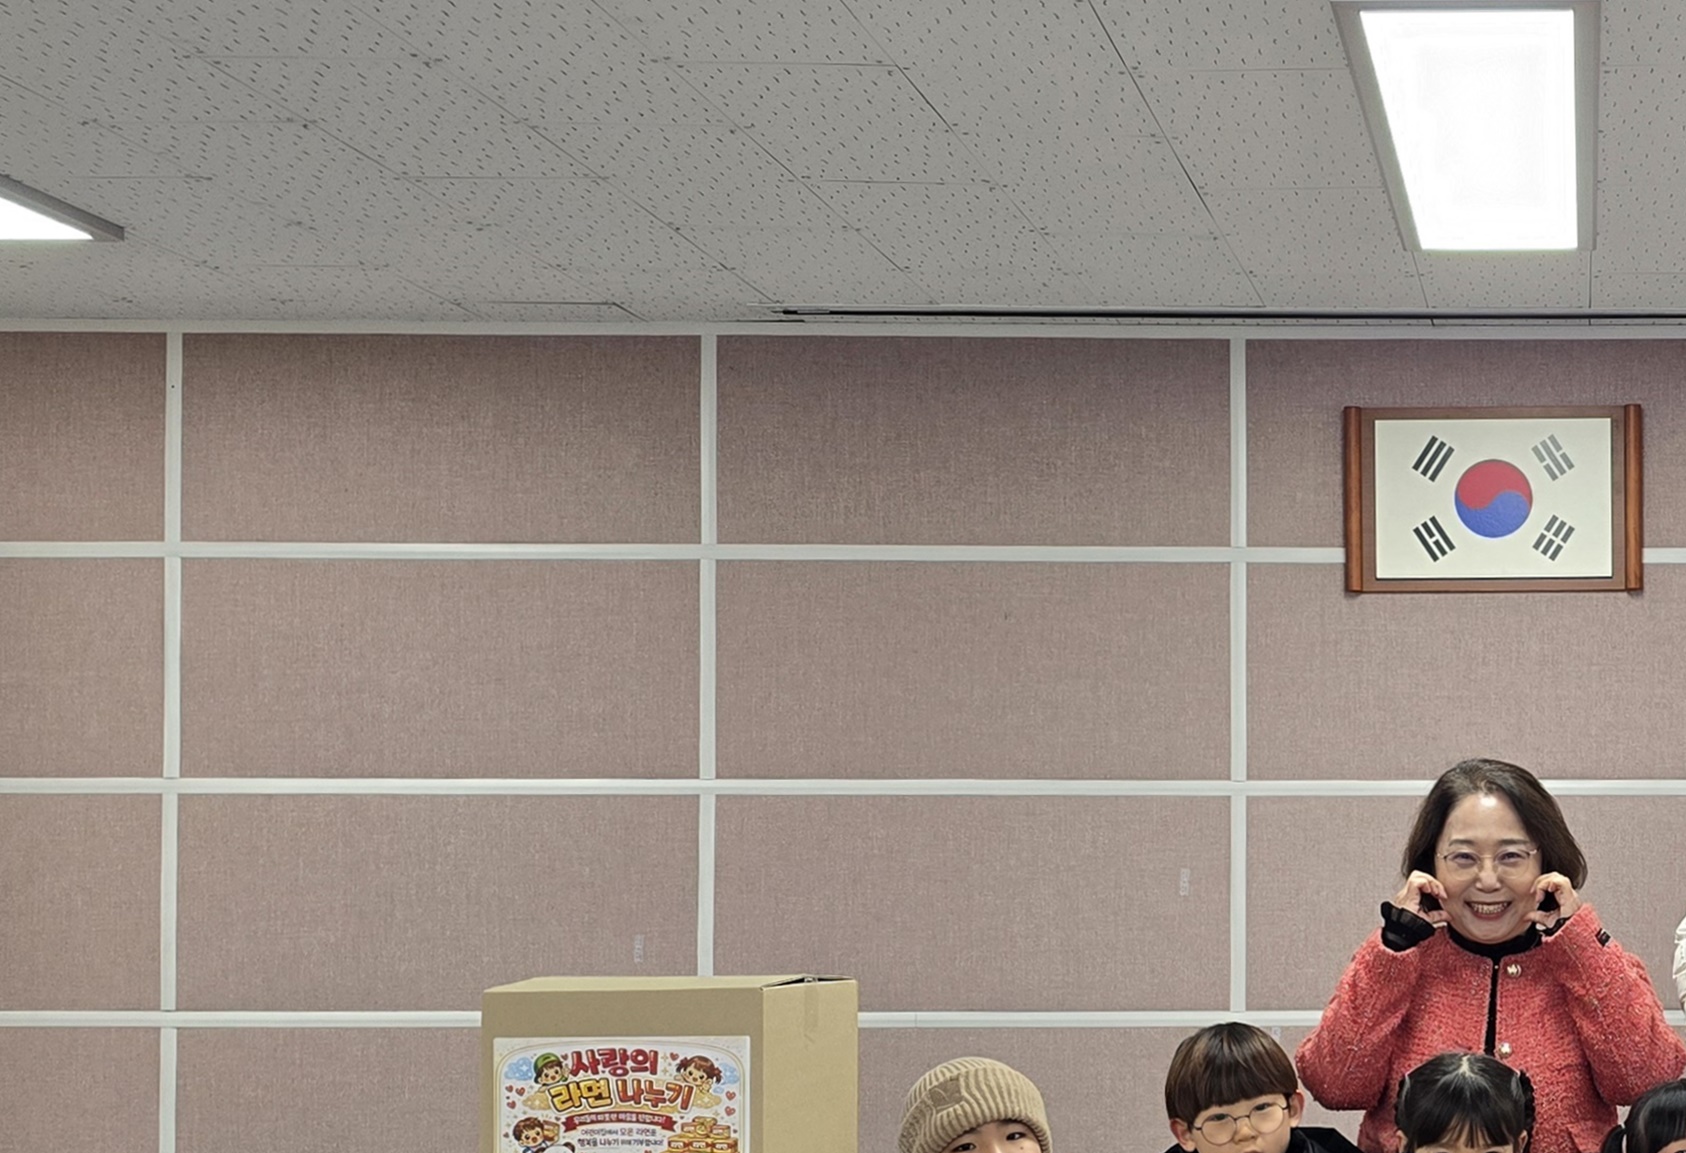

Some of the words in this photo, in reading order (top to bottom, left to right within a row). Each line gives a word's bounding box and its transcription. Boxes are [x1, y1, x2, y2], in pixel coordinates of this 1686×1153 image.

[569, 1048, 658, 1076] 사랑의
[548, 1078, 612, 1111] 라면
[617, 1079, 695, 1110] 나누기
